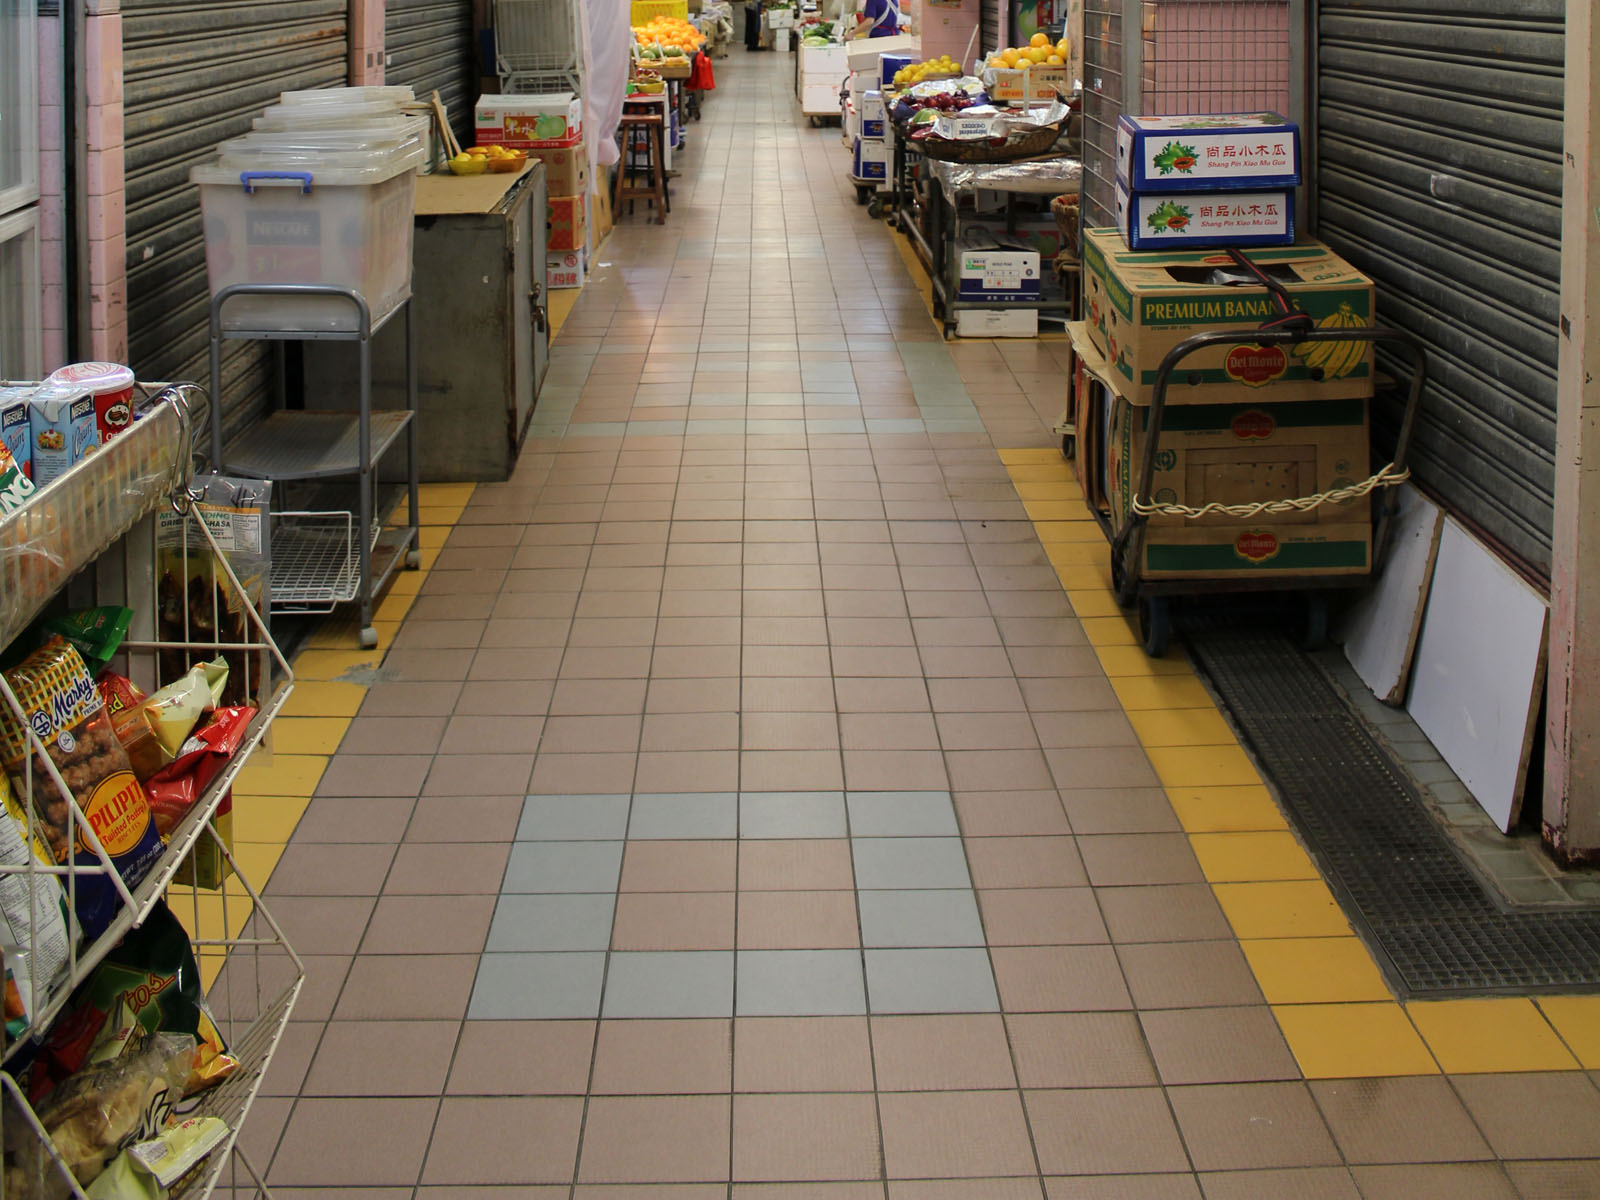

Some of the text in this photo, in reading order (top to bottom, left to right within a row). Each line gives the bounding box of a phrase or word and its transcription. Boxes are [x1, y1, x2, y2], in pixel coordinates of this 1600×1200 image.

[1206, 144, 1286, 158] 尚品小木瓜
[1200, 204, 1278, 218] 尚品小木瓜
[1145, 302, 1221, 320] PREMIUM
[1230, 356, 1283, 368] Del Monte
[88, 780, 142, 836] PILIPIT
